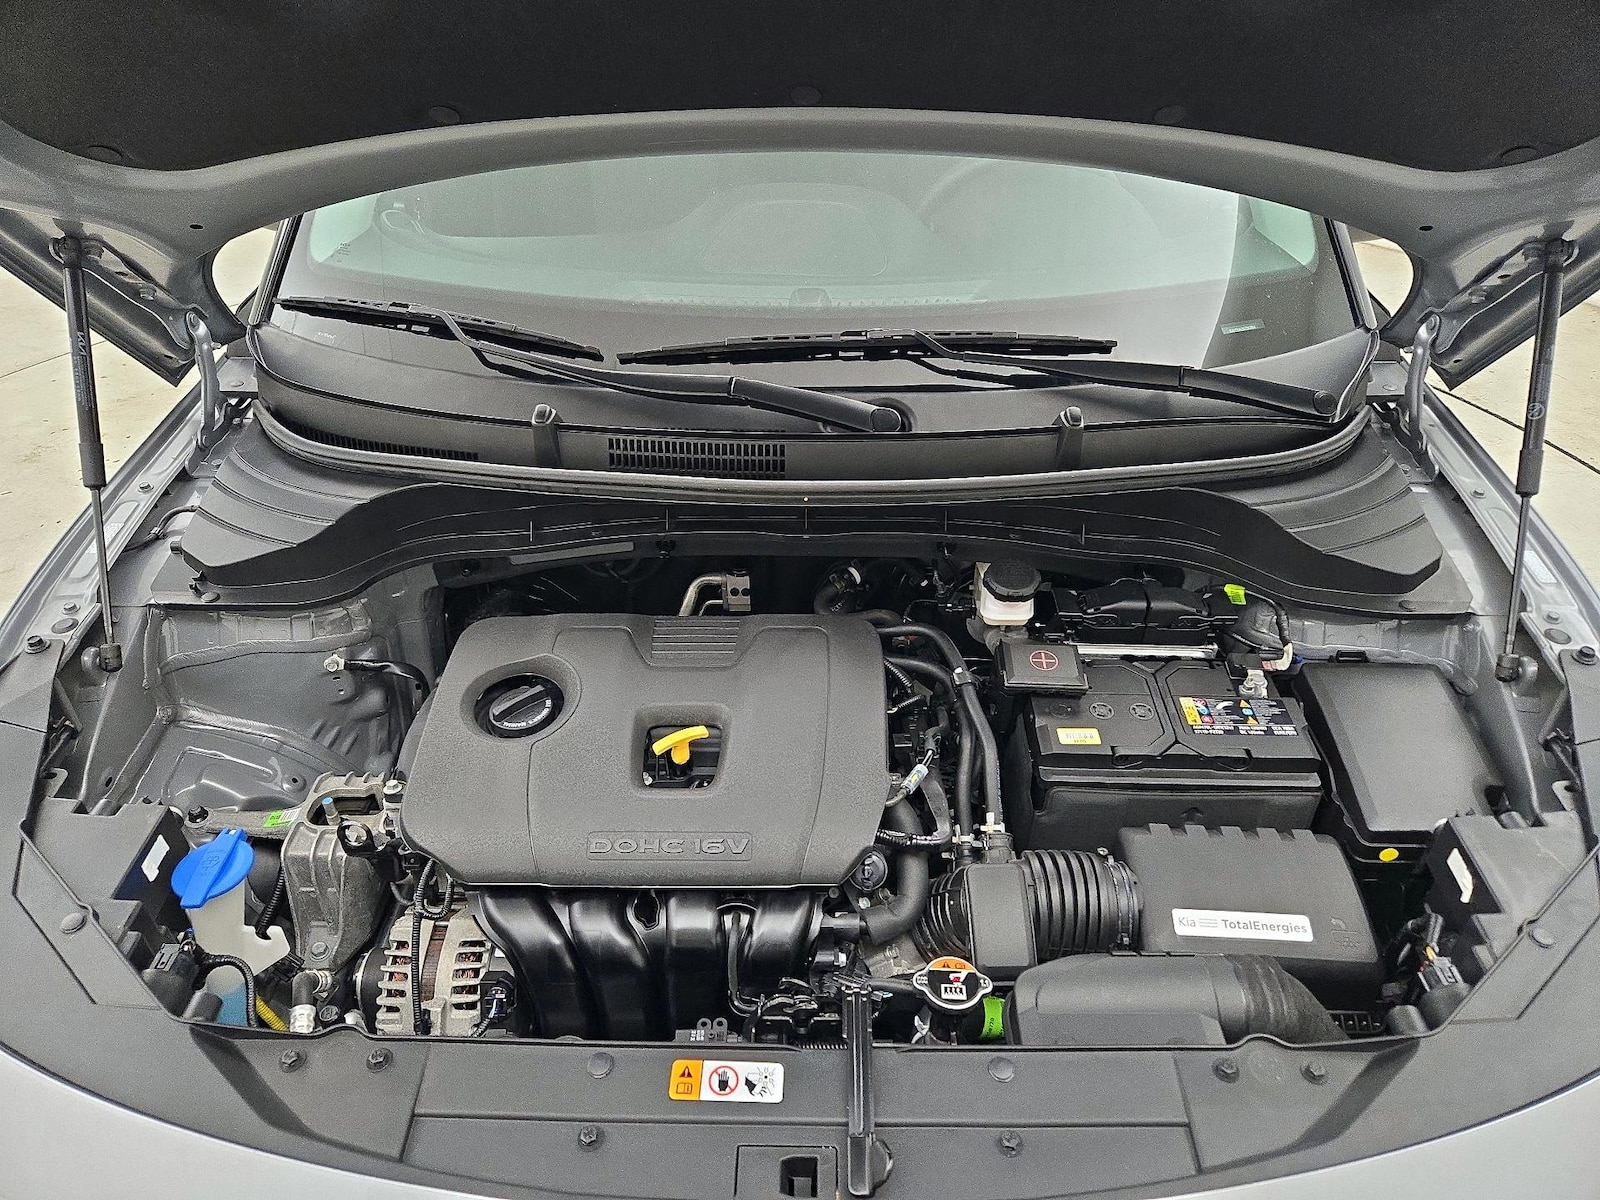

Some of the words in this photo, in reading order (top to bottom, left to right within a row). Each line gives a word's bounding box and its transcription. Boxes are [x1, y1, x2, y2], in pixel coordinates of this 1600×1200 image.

[588, 837, 686, 854] DOHC
[692, 837, 750, 855] 16V
[1177, 916, 1197, 928] Kia
[1220, 918, 1308, 935] TotalEnergies
